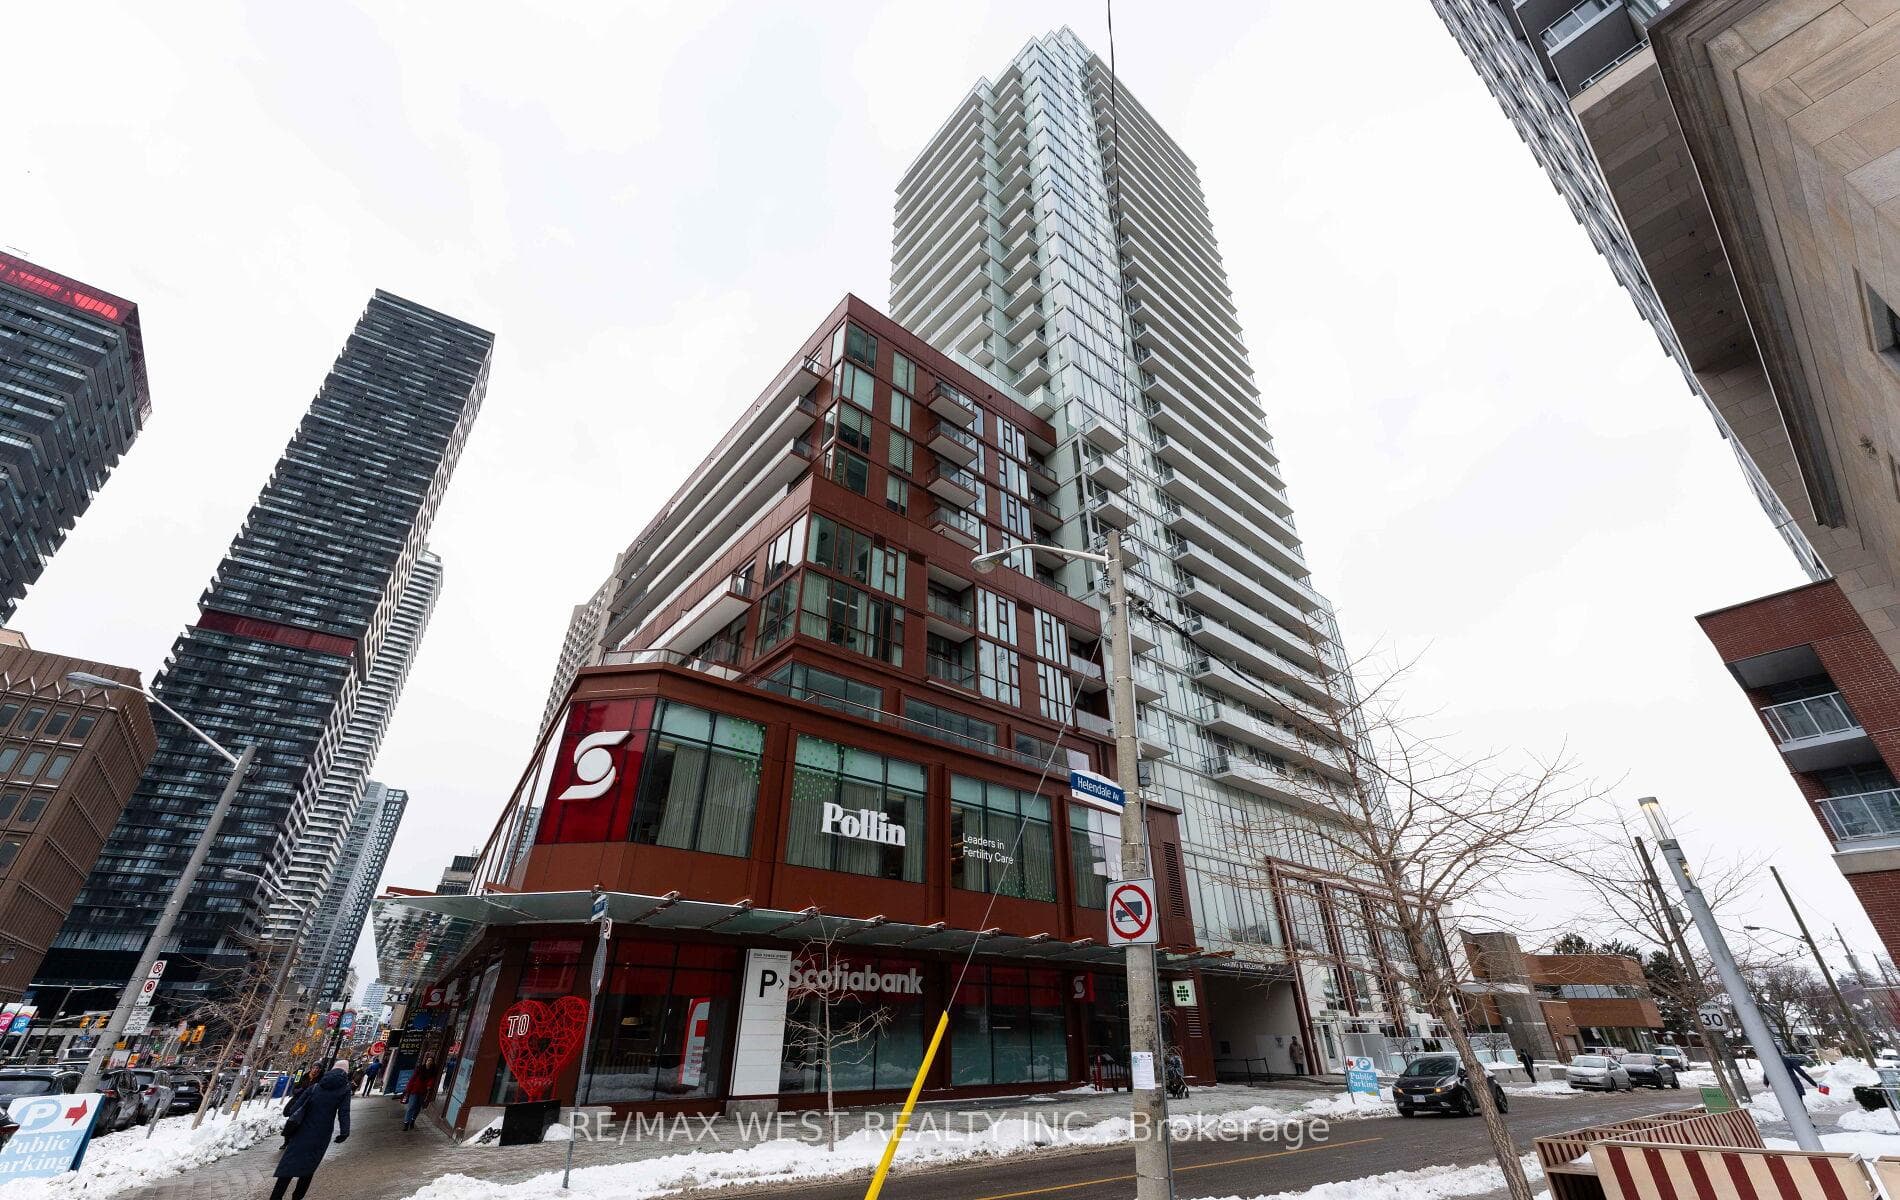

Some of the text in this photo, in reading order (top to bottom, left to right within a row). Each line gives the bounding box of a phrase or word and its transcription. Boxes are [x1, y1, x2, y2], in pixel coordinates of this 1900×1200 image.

[1077, 776, 1112, 799] Helendale
[821, 802, 906, 847] Pollin
[962, 832, 1005, 850] Leaders in
[962, 846, 1014, 865] Fertility Care
[759, 969, 778, 998] P
[789, 959, 923, 994] Scotiabank
[508, 1014, 530, 1037] TO
[1699, 1013, 1723, 1027] 30
[1351, 1072, 1373, 1080] Public
[0, 1135, 71, 1156] Public
[0, 1152, 72, 1174] arking
